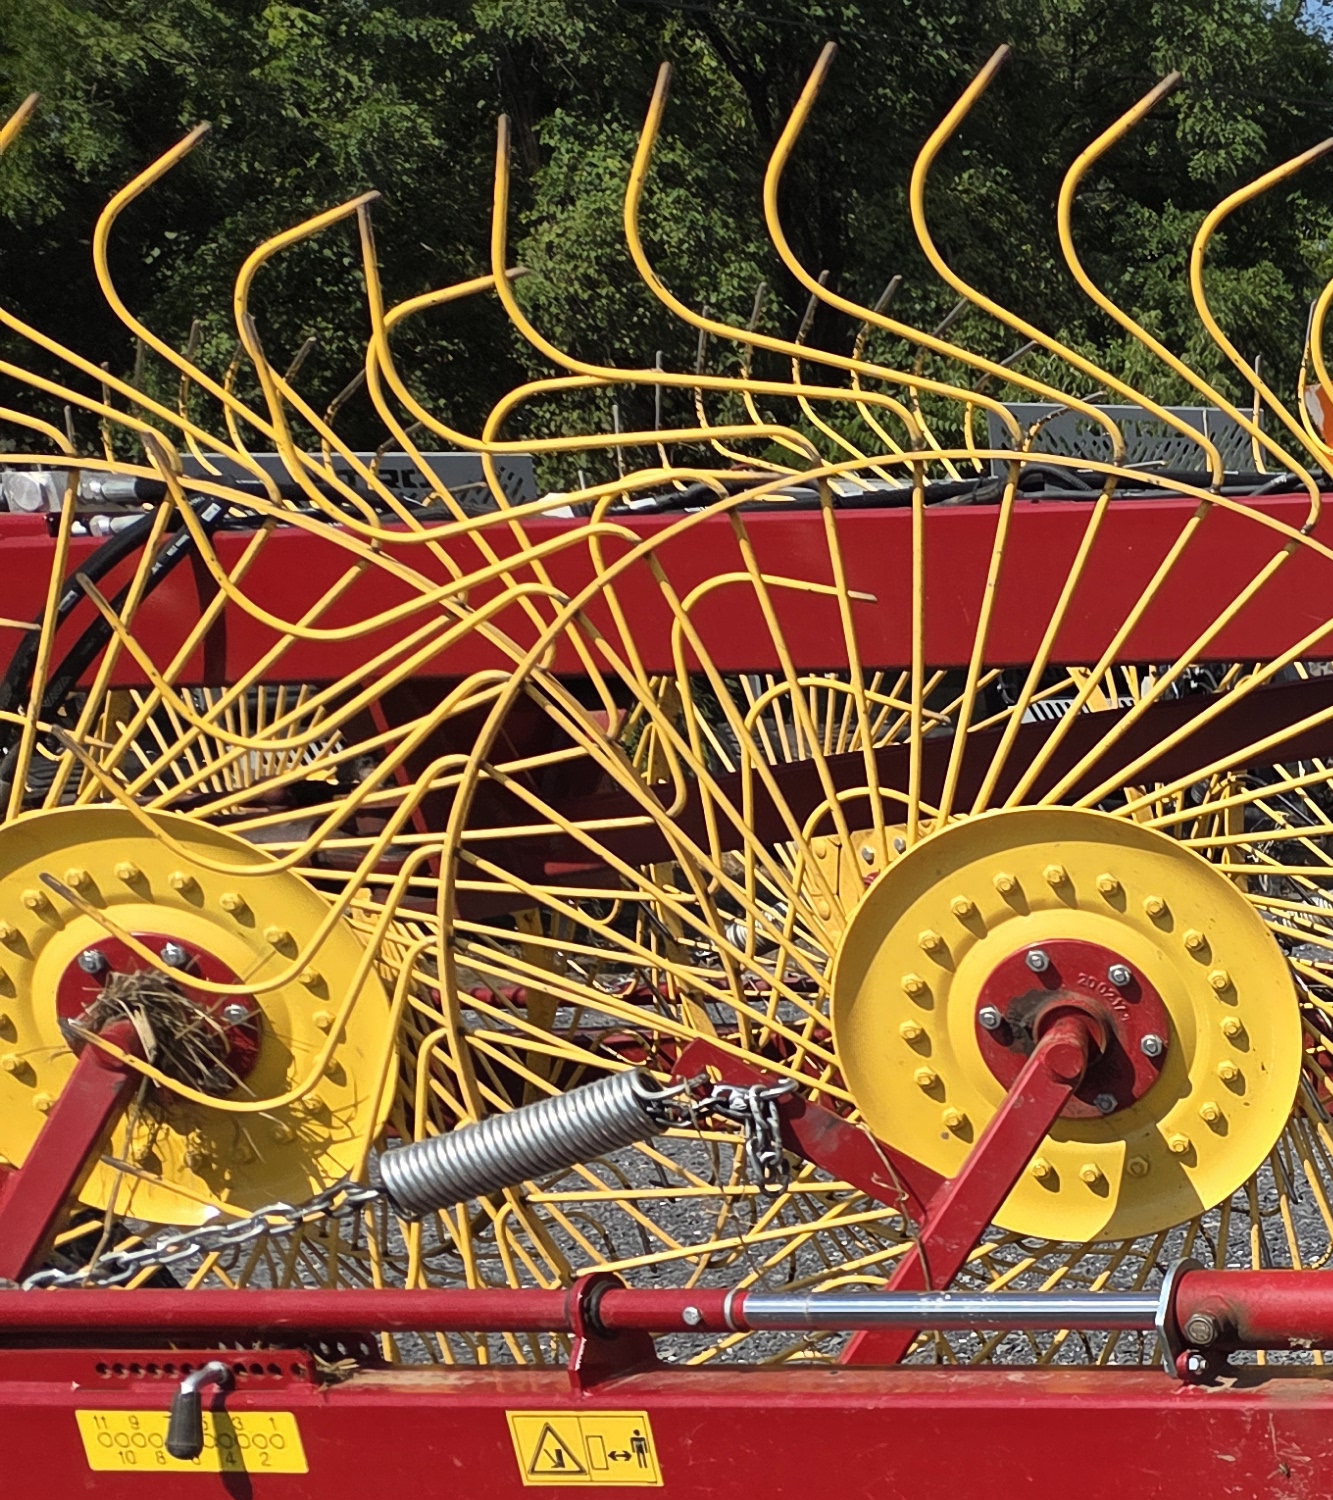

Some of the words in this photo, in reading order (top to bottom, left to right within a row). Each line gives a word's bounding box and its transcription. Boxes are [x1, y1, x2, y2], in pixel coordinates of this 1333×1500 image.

[93, 1415, 109, 1430] 11
[128, 1415, 140, 1431] 9
[232, 1416, 244, 1431] 3
[269, 1416, 279, 1431] 1
[118, 1451, 137, 1465] 10
[155, 1451, 167, 1466] 8
[225, 1451, 238, 1466] 4
[259, 1452, 271, 1467] 2
